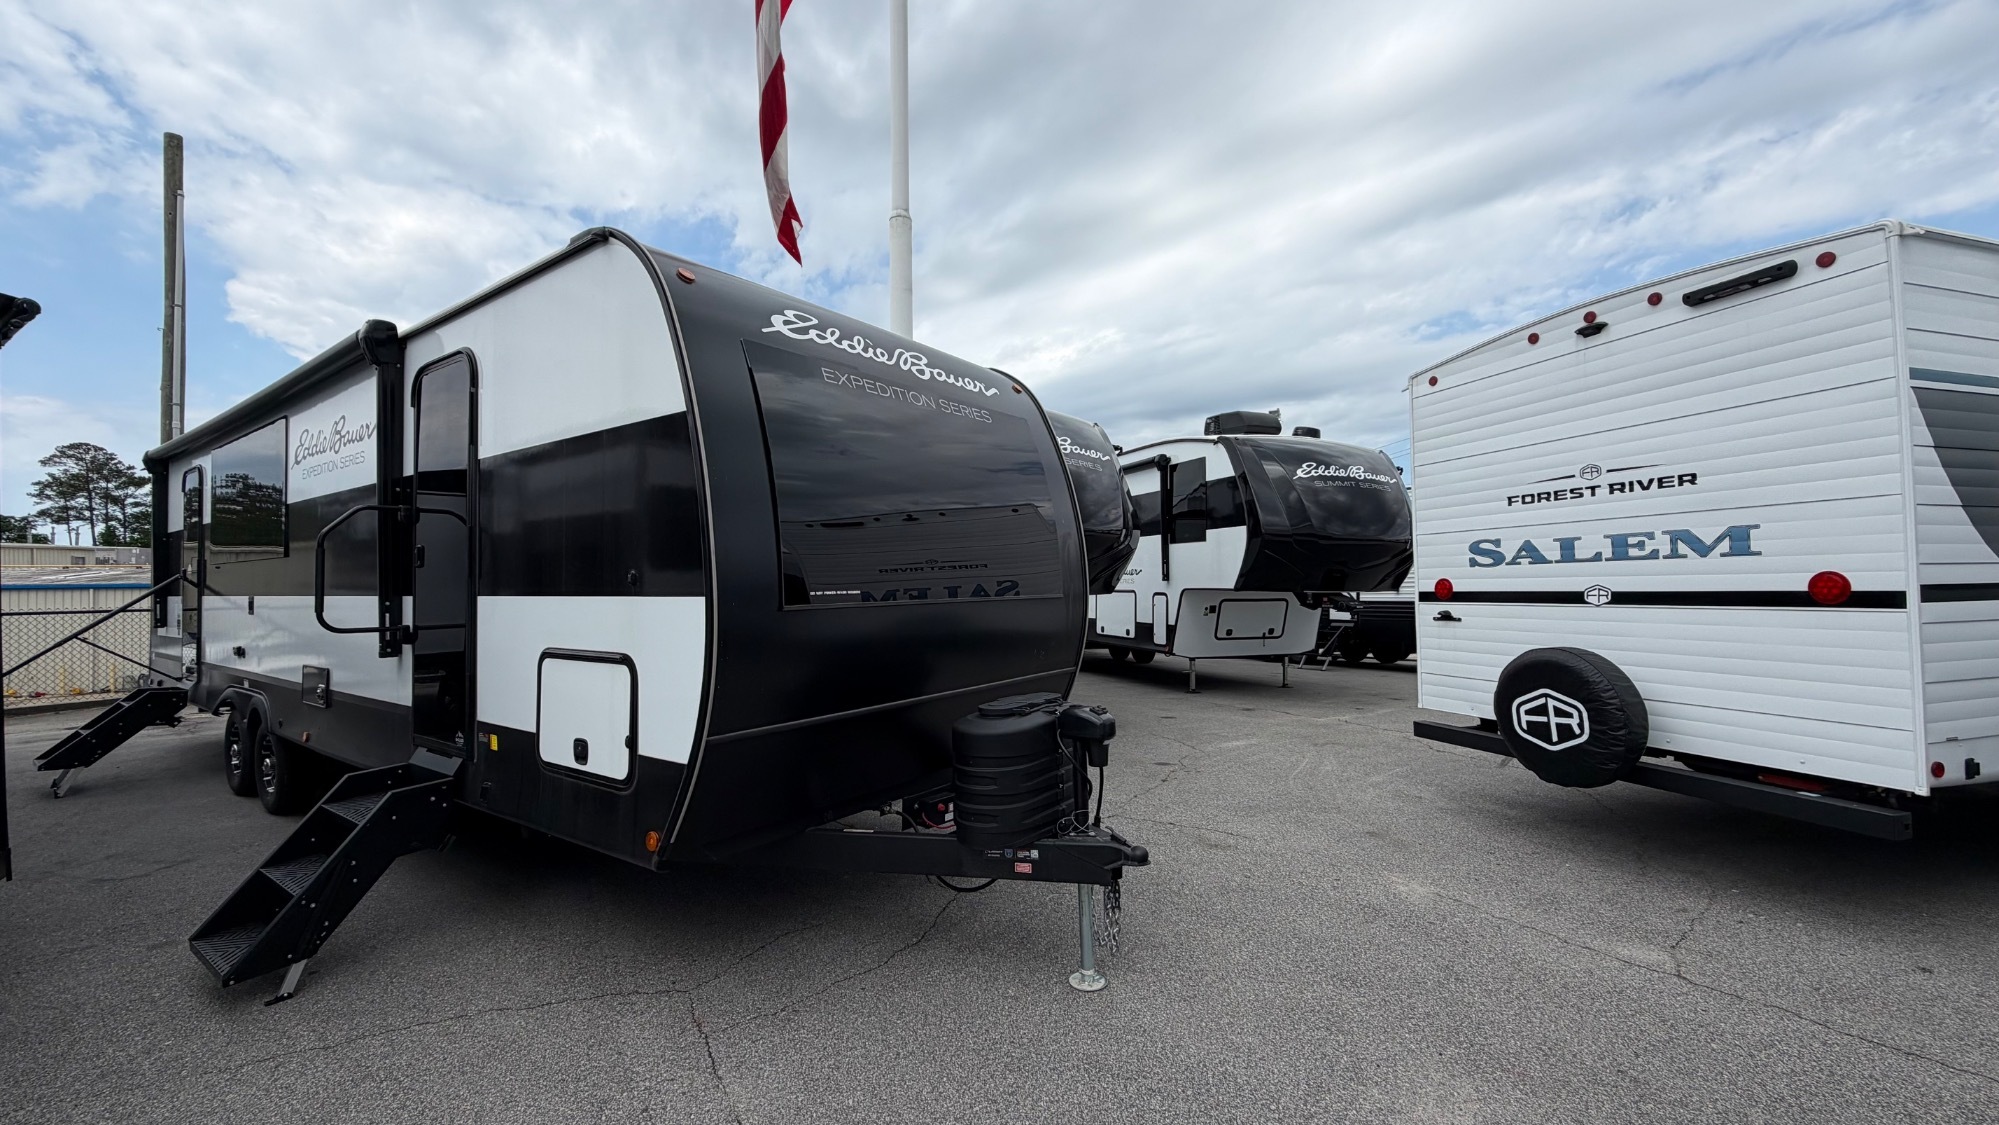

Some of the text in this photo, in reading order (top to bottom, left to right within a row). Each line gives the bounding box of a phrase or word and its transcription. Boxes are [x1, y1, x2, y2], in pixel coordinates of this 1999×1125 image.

[760, 309, 1000, 397] Eddie Bauer
[821, 367, 993, 424] EXPEDITION SERIES
[290, 414, 377, 470] Eddie Bauer
[1056, 435, 1111, 461] Bauer
[301, 450, 366, 480] EXPEDITION SERIES
[1293, 461, 1398, 484] Eddie Bauer
[1314, 480, 1392, 492] SUMMIT SERIES
[1506, 472, 1698, 507] FOREST RIVER
[1468, 523, 1763, 569] SALEM
